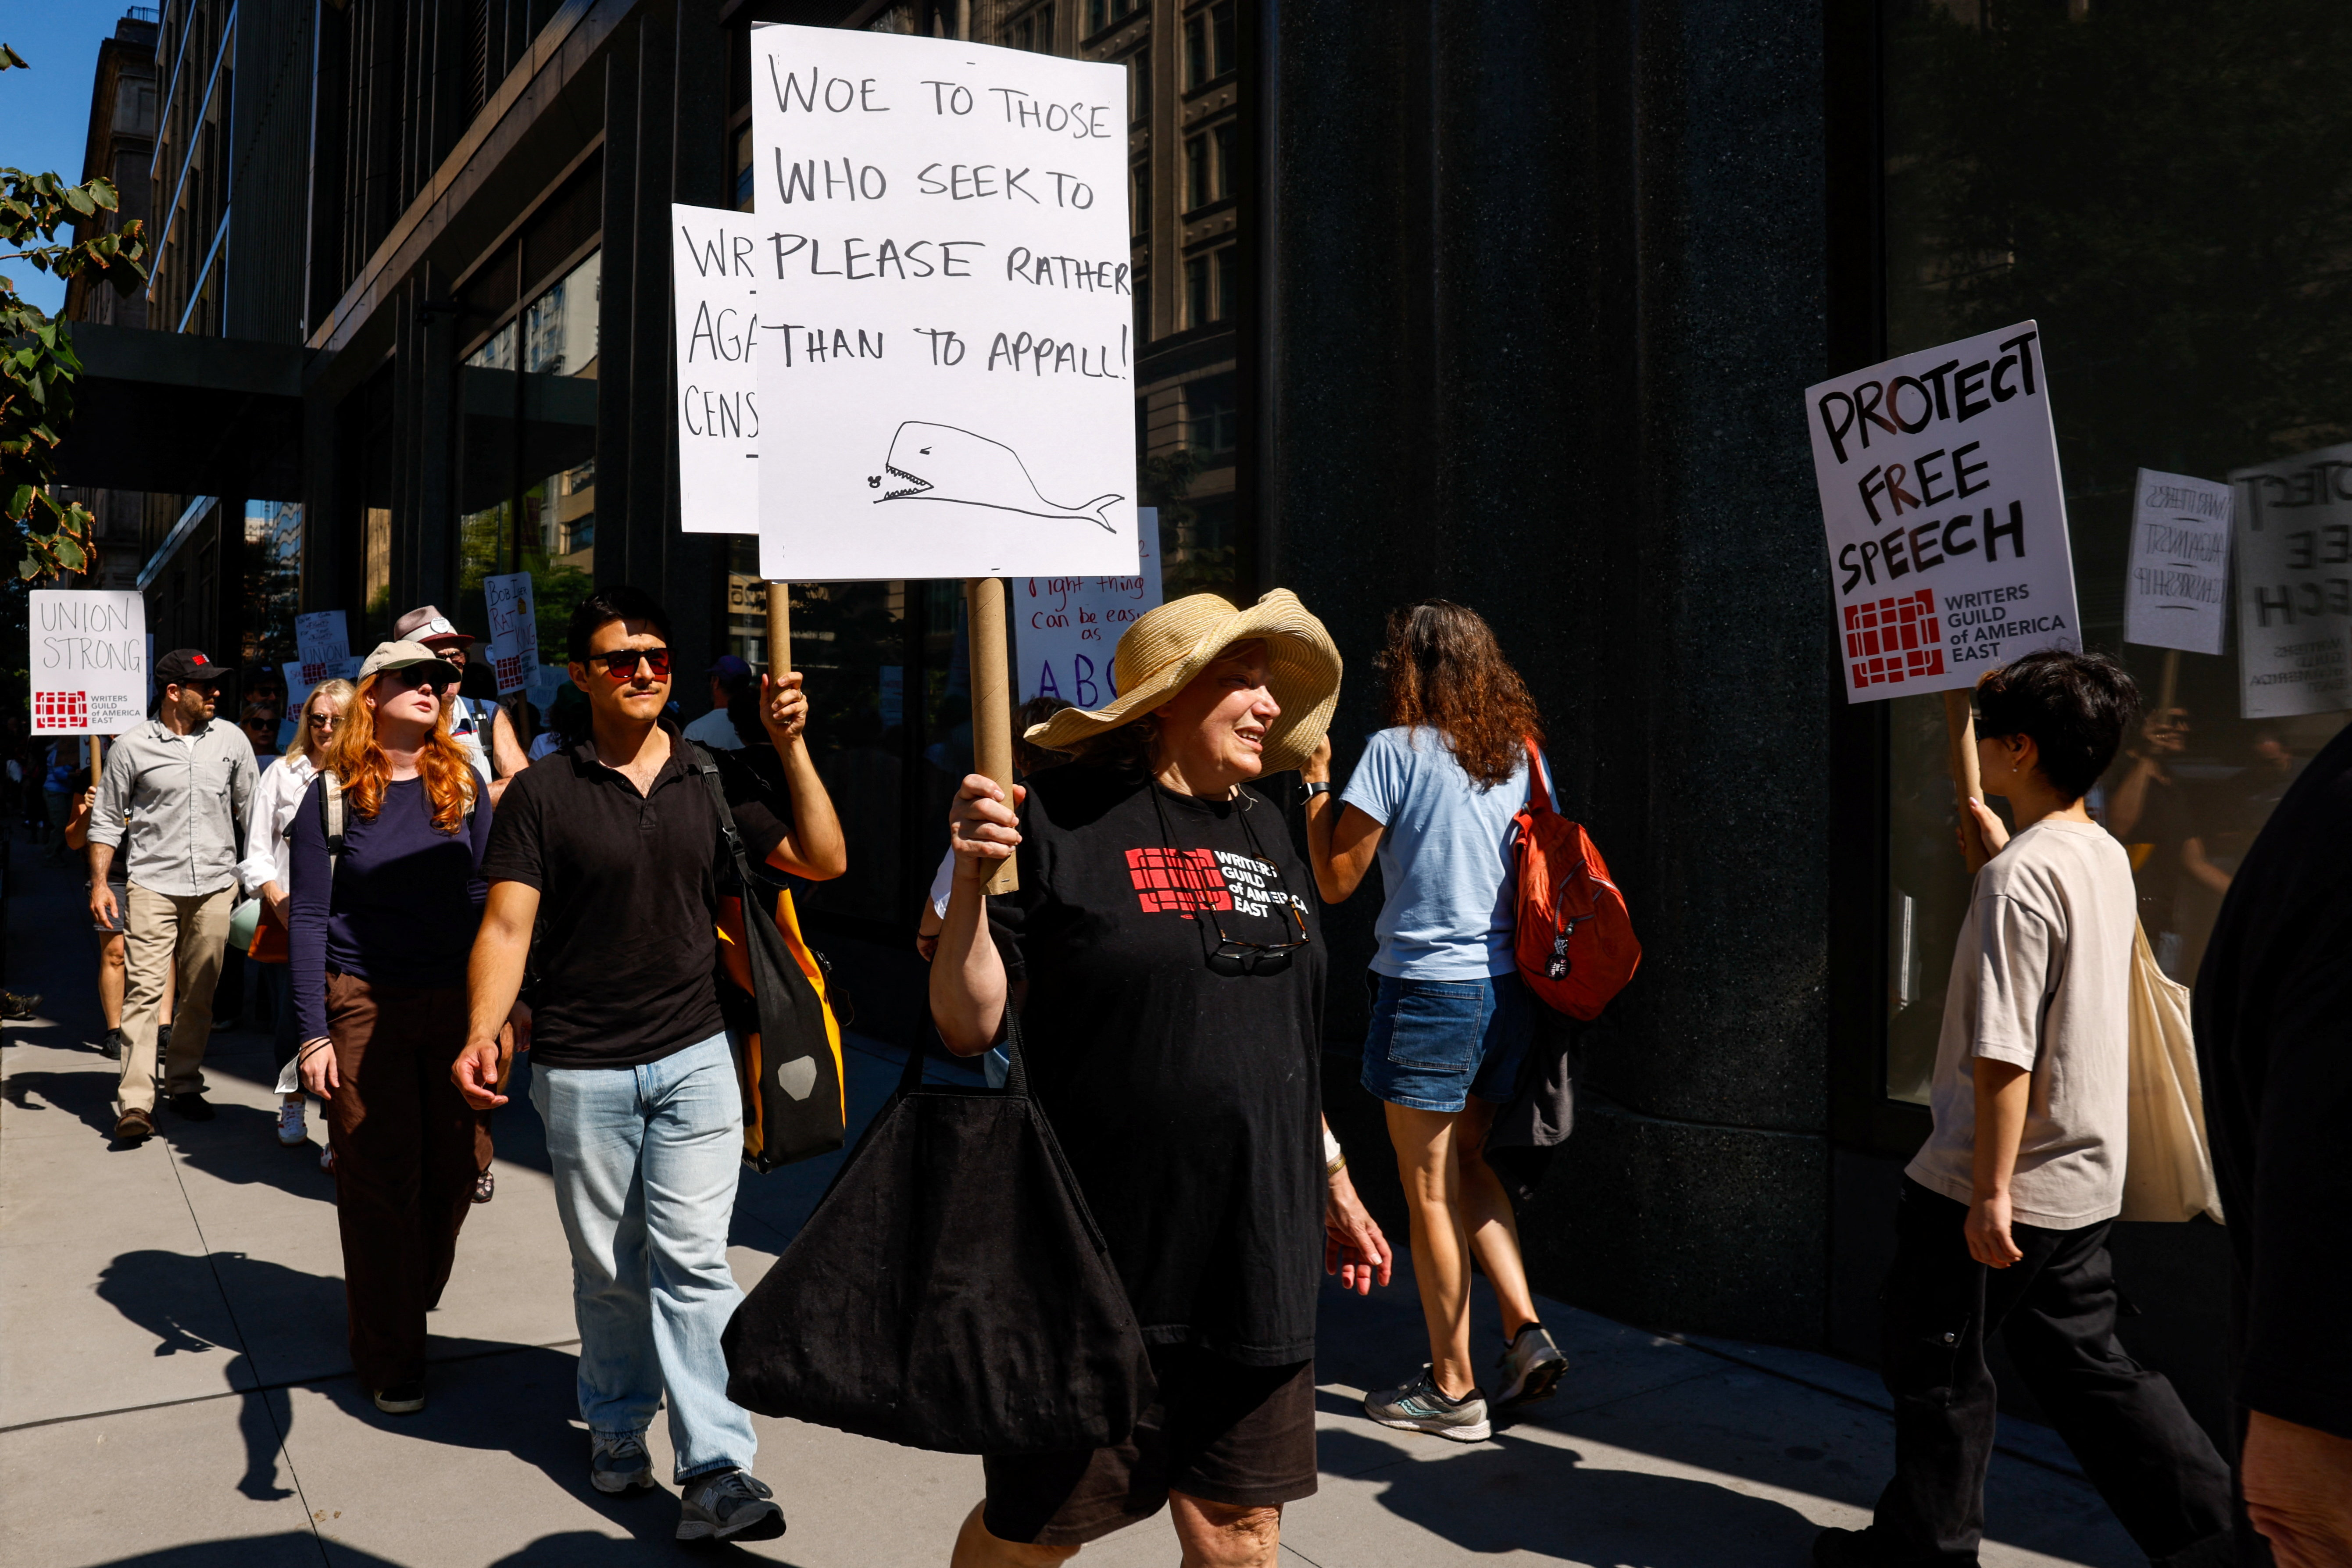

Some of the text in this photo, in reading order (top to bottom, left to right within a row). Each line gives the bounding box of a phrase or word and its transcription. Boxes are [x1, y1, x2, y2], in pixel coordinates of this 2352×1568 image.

[769, 54, 1112, 139] WOE TO THOSE
[775, 147, 1094, 210] WHO SEEK TO
[682, 225, 754, 277] WR
[767, 232, 1131, 295] PLEASE RATHER
[761, 323, 1127, 381] THAN TO APPALL!
[684, 385, 758, 438] CENS
[1819, 331, 2037, 465] PROTECT
[1858, 440, 1991, 526] FREE
[1838, 500, 2025, 596] SPEECH
[1945, 584, 2030, 612] WRITERS
[41, 598, 129, 633] UNION
[490, 608, 515, 631] RAT
[1079, 607, 1098, 624] be
[1947, 606, 2007, 628] GUILD
[1950, 615, 2067, 646] of AMERICA
[1081, 627, 1101, 641] as
[44, 637, 140, 673] STRONG
[1952, 643, 2000, 663] EAST
[1214, 850, 1278, 879] WRITERS
[1221, 867, 1265, 888] GUILD
[1229, 882, 1309, 914] of AMERCA
[1233, 896, 1269, 918] EAST
